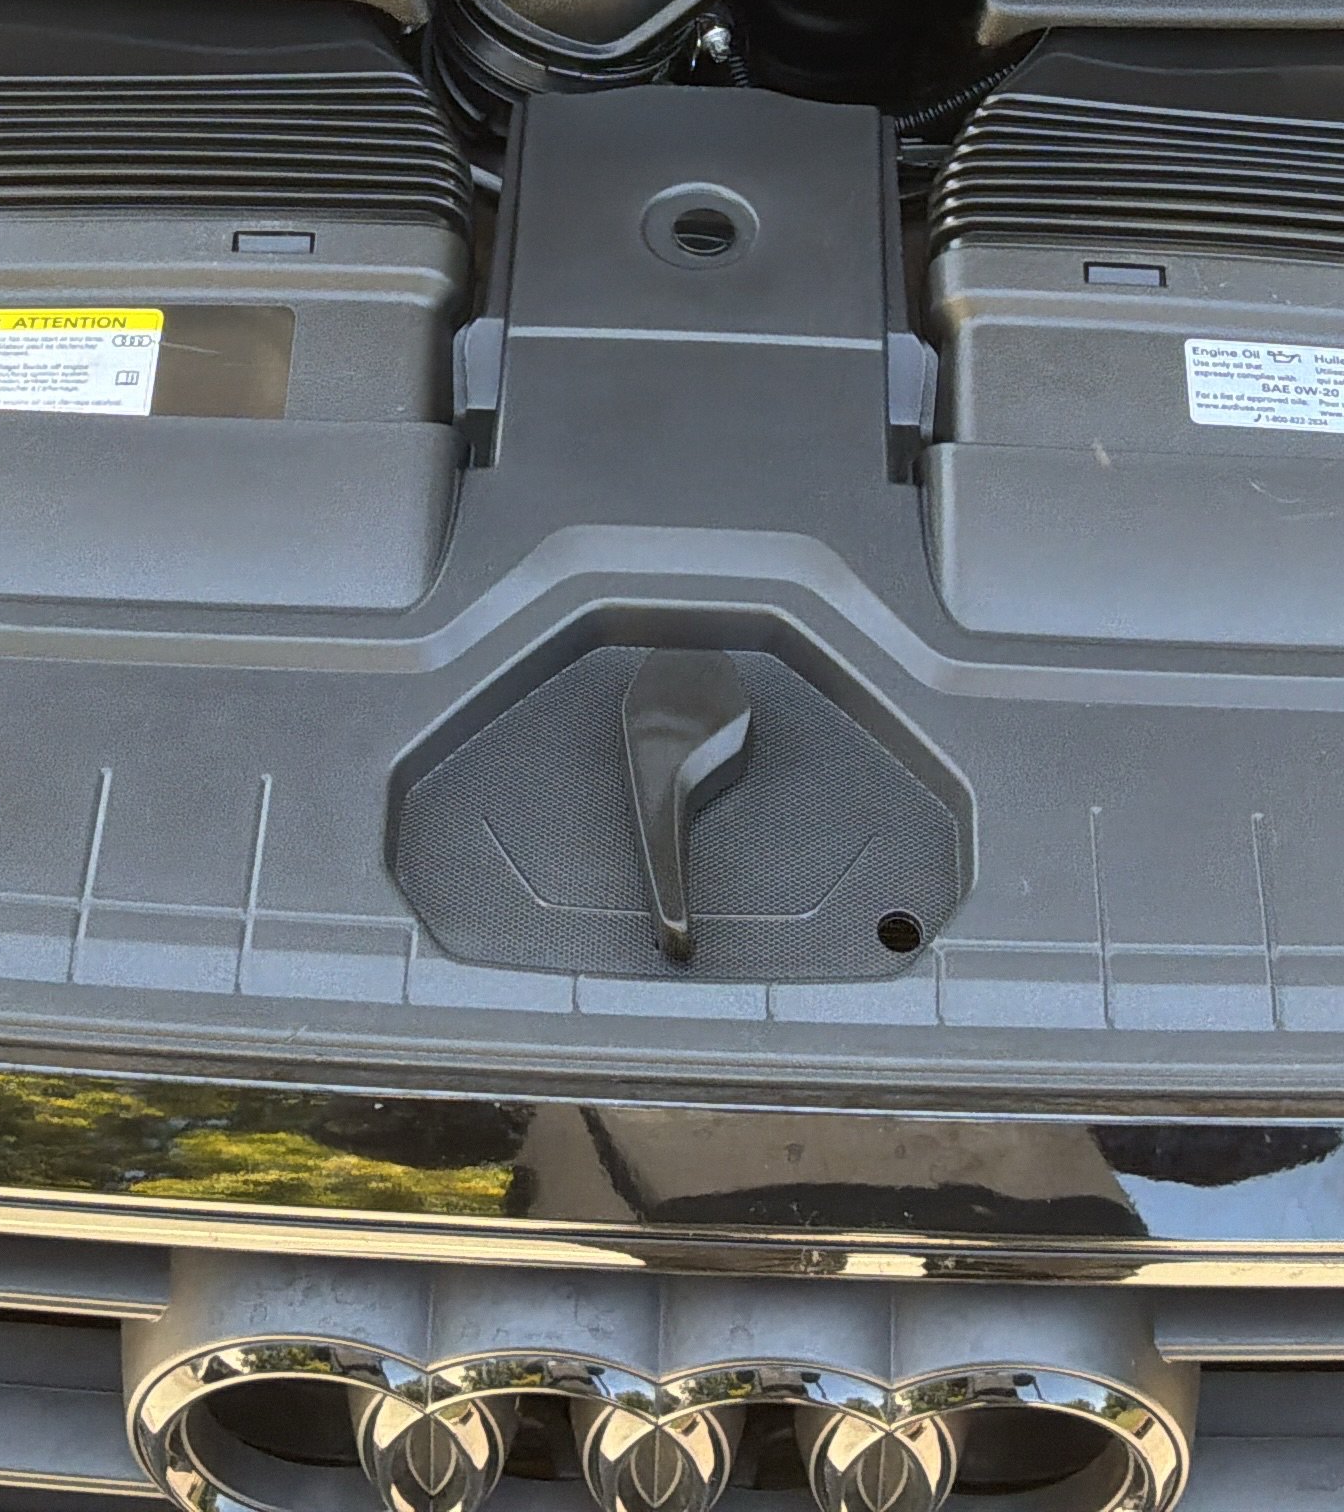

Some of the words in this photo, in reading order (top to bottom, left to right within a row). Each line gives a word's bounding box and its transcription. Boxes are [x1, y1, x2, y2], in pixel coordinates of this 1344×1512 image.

[11, 316, 128, 330] ATTENTION
[1191, 346, 1238, 359] Engine
[1241, 348, 1261, 360] Oil
[1192, 358, 1210, 367] Use
[1211, 361, 1232, 370] only
[1244, 362, 1263, 370] that
[1193, 369, 1235, 380] expressly
[1277, 374, 1297, 383] with
[1316, 379, 1331, 387] qui
[1260, 383, 1291, 394] SAE
[1293, 386, 1340, 397] 0W-20
[1194, 390, 1211, 400] For
[1220, 392, 1234, 401] list
[1235, 393, 1245, 401] of
[1246, 394, 1289, 405] approved
[1317, 399, 1340, 408] Pour
